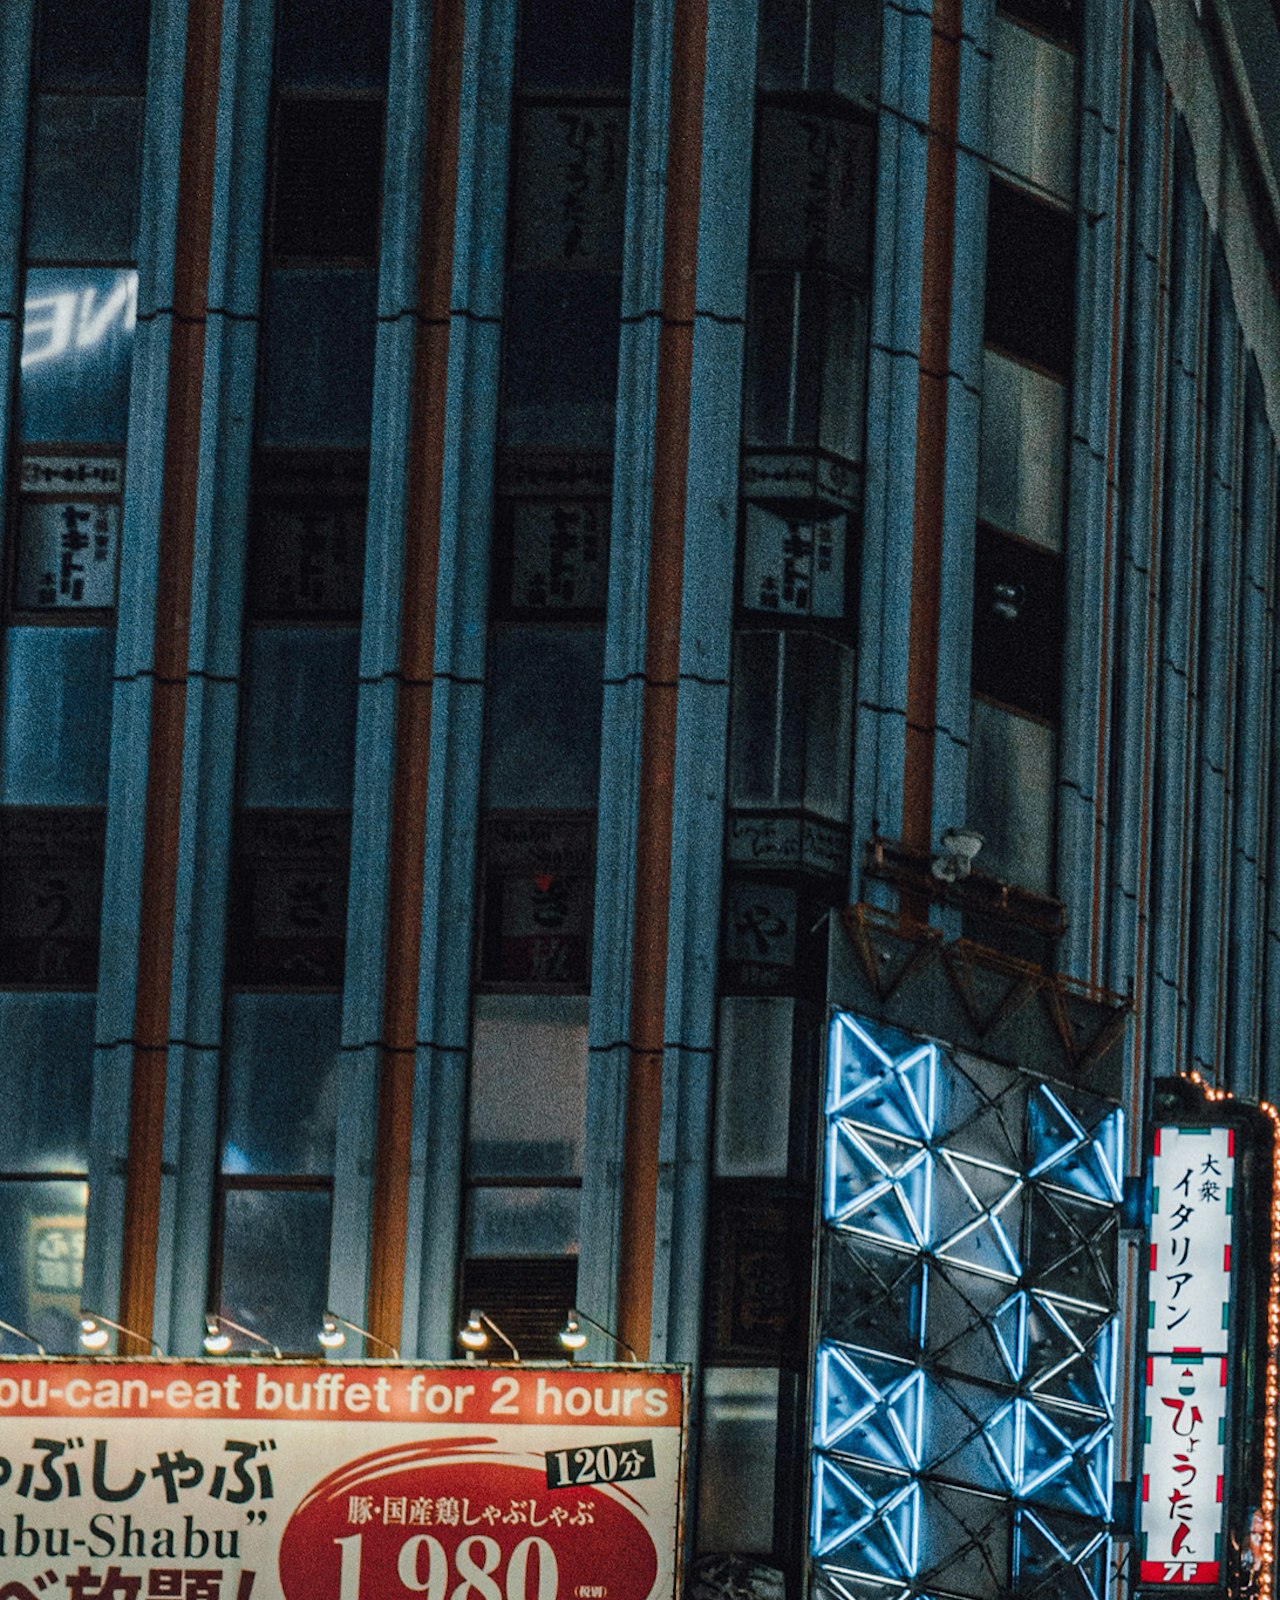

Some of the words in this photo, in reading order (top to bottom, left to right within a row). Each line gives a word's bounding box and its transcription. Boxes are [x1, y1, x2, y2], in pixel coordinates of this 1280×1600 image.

[1166, 1167, 1195, 1332] イタリアン
[255, 1372, 389, 1414] buffet
[406, 1374, 475, 1414] for
[489, 1377, 520, 1415] 2
[535, 1378, 670, 1417] hours
[556, 1445, 646, 1487] 120分
[1161, 1397, 1204, 1557] ひょうたん
[1162, 1563, 1198, 1581] 7F
